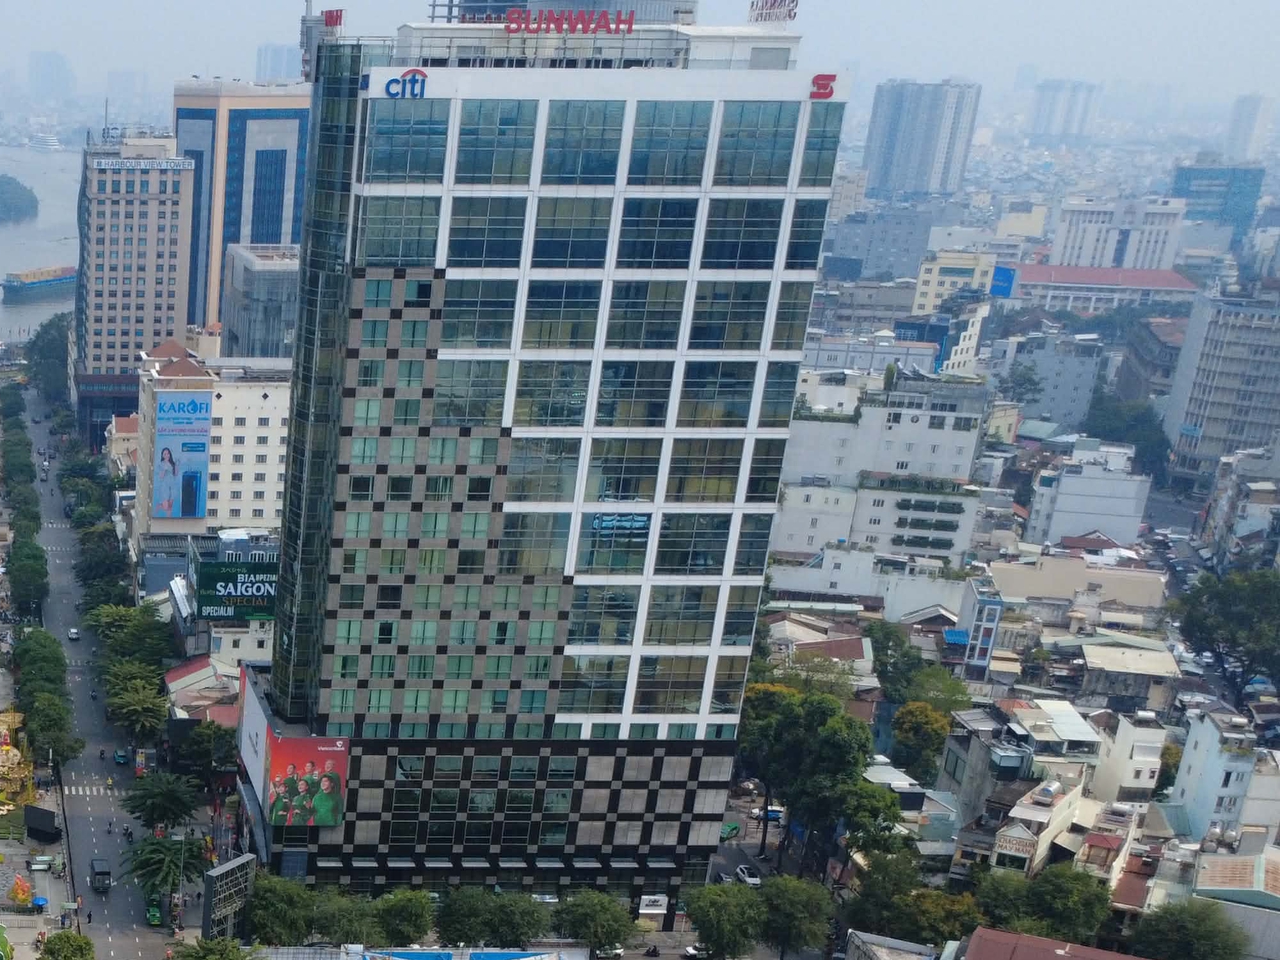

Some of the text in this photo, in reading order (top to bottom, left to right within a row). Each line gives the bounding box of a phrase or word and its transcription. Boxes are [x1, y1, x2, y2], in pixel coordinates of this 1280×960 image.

[504, 8, 635, 34] SUNWAH
[385, 70, 427, 99] citi
[165, 161, 193, 169] TOWER
[158, 399, 209, 414] KAROFI
[238, 574, 255, 582] BIA
[216, 582, 276, 596] SAIGON
